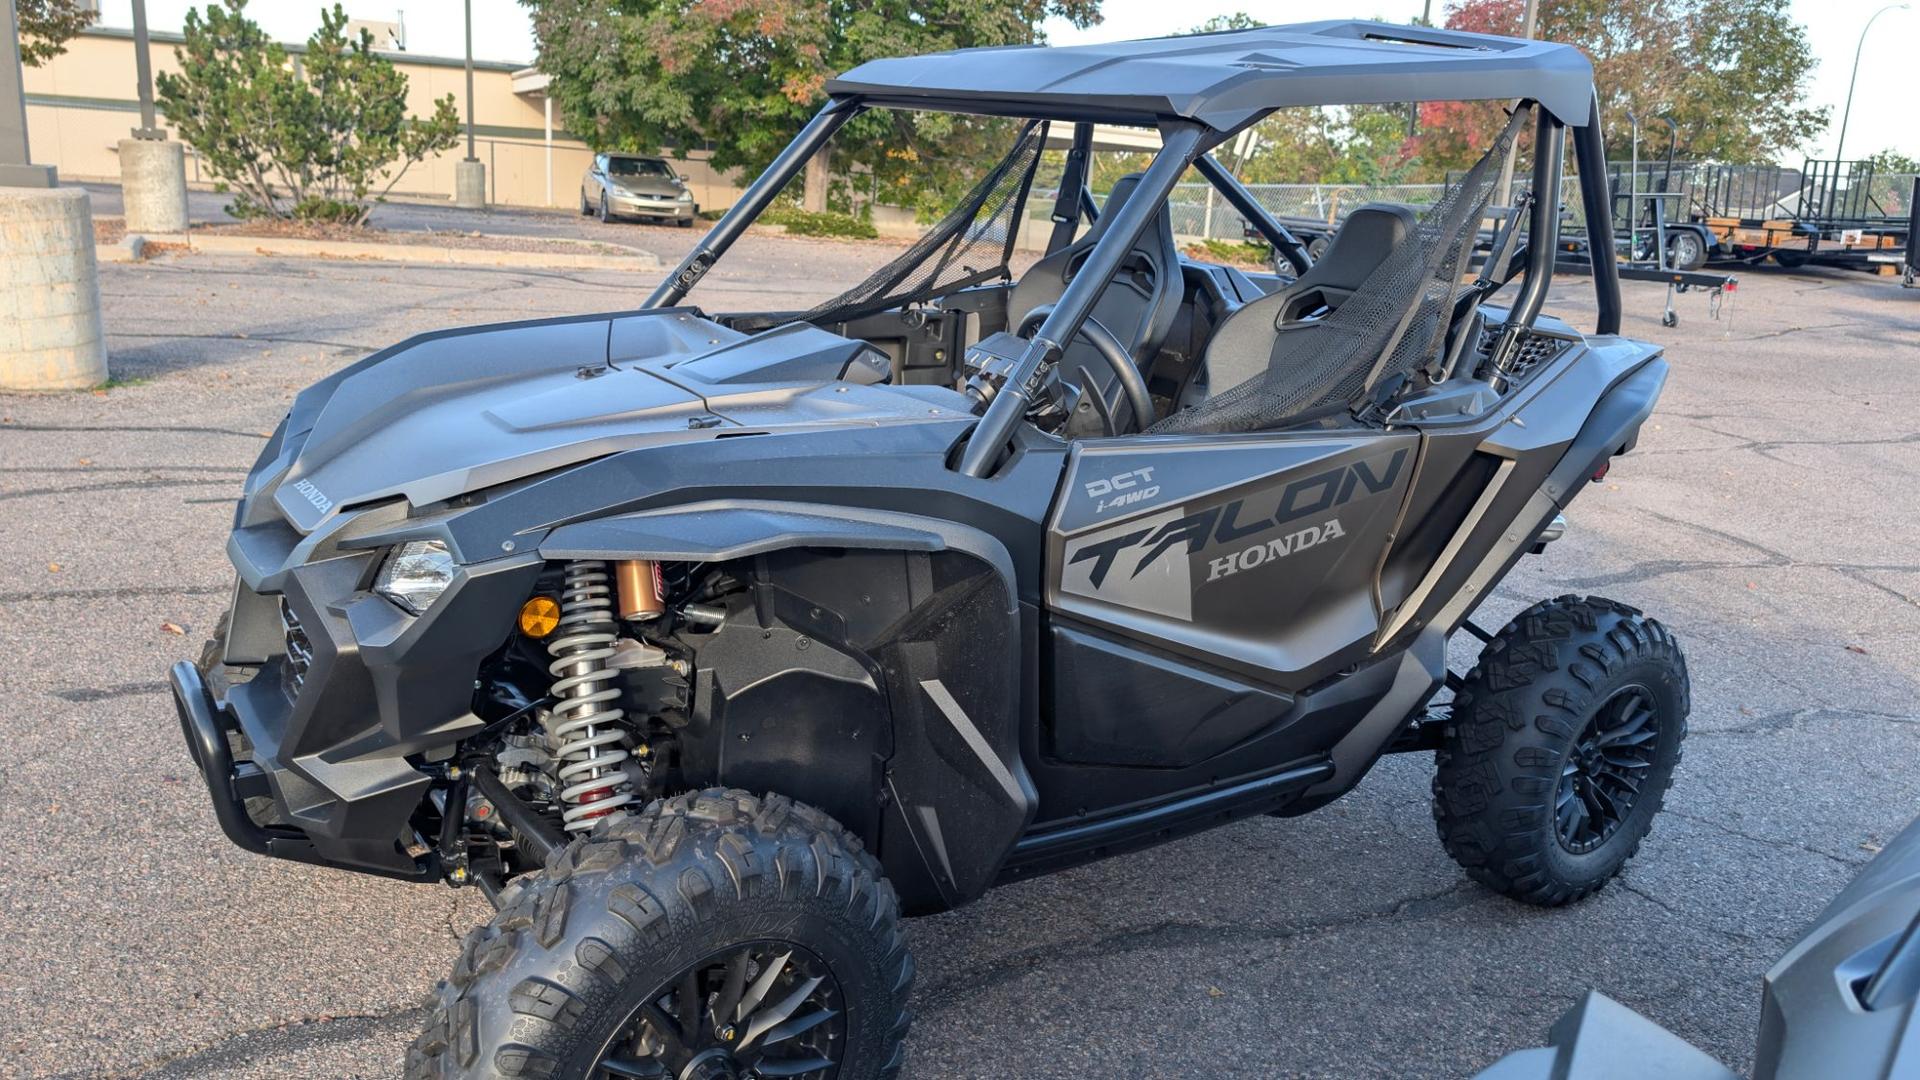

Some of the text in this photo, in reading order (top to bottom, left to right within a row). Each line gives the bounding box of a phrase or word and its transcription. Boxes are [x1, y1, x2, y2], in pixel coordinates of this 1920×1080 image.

[293, 479, 333, 514] HONDA
[1085, 466, 1154, 498] DCT
[1068, 448, 1409, 590] TALON
[1206, 518, 1345, 582] HONDA
